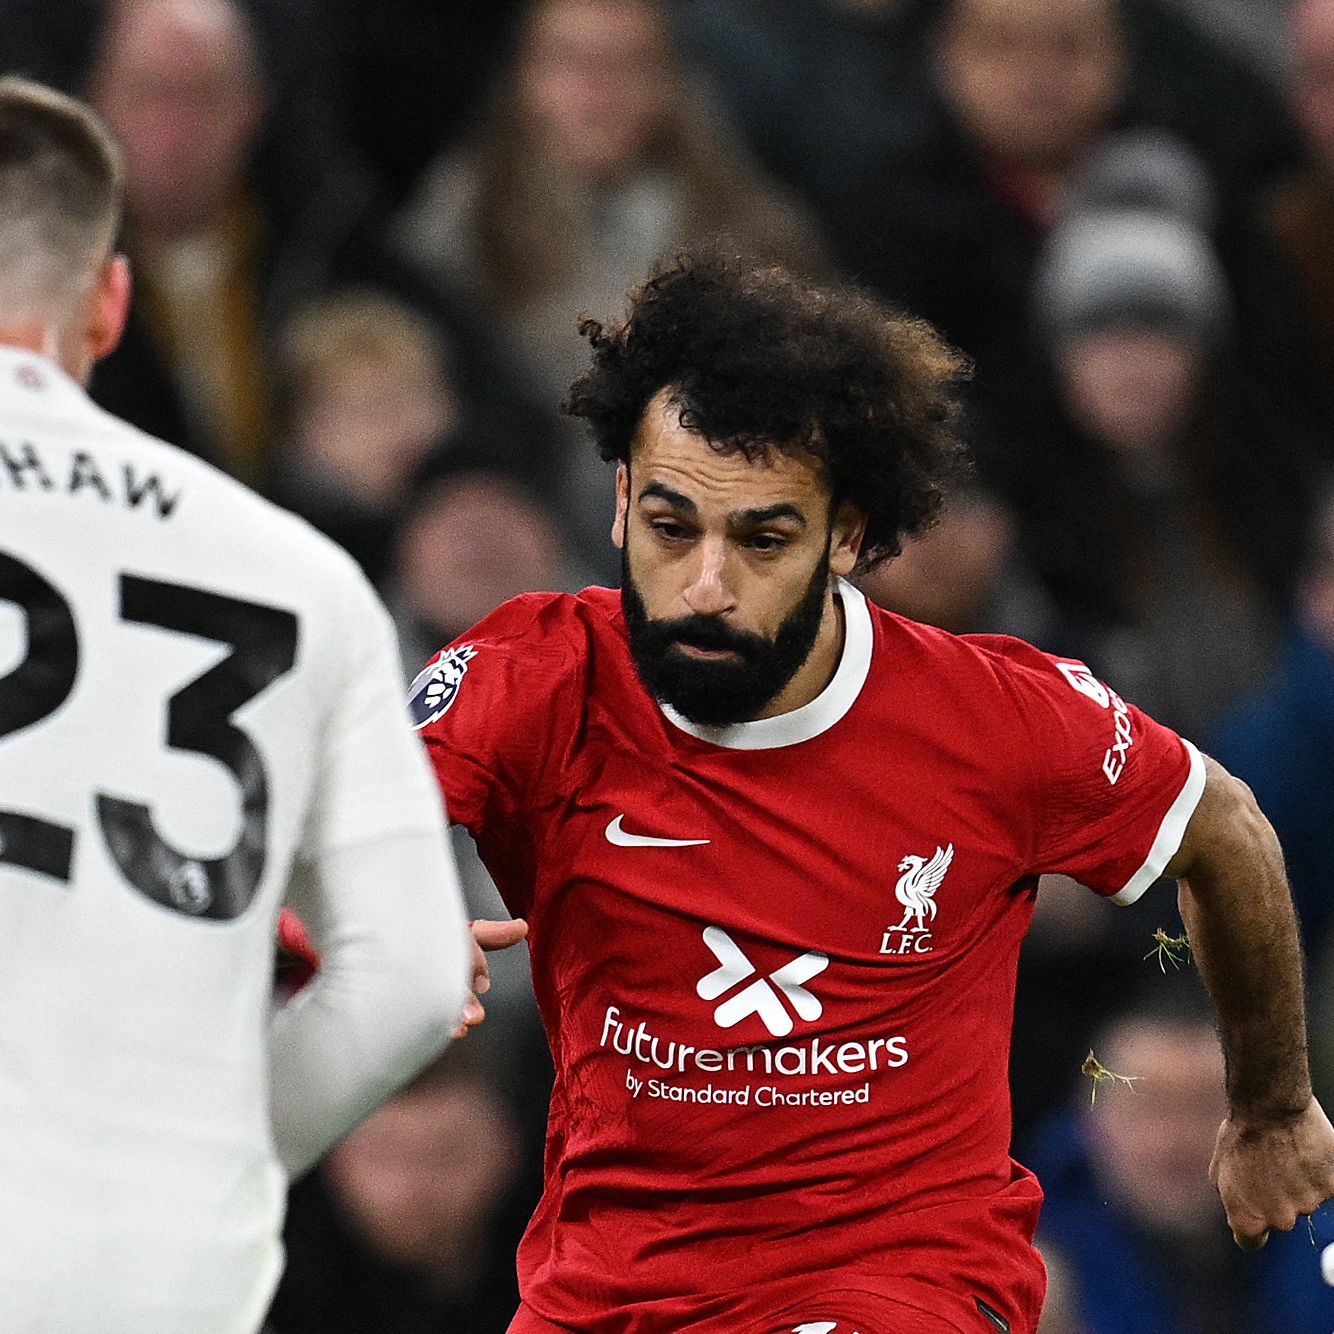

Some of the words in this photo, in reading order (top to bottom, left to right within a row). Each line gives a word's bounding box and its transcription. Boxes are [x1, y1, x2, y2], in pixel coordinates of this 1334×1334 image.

[598, 1005, 909, 1076] futuremakers
[625, 1068, 643, 1099] by
[647, 1079, 750, 1106] Standard
[754, 1083, 870, 1107] Chartered
